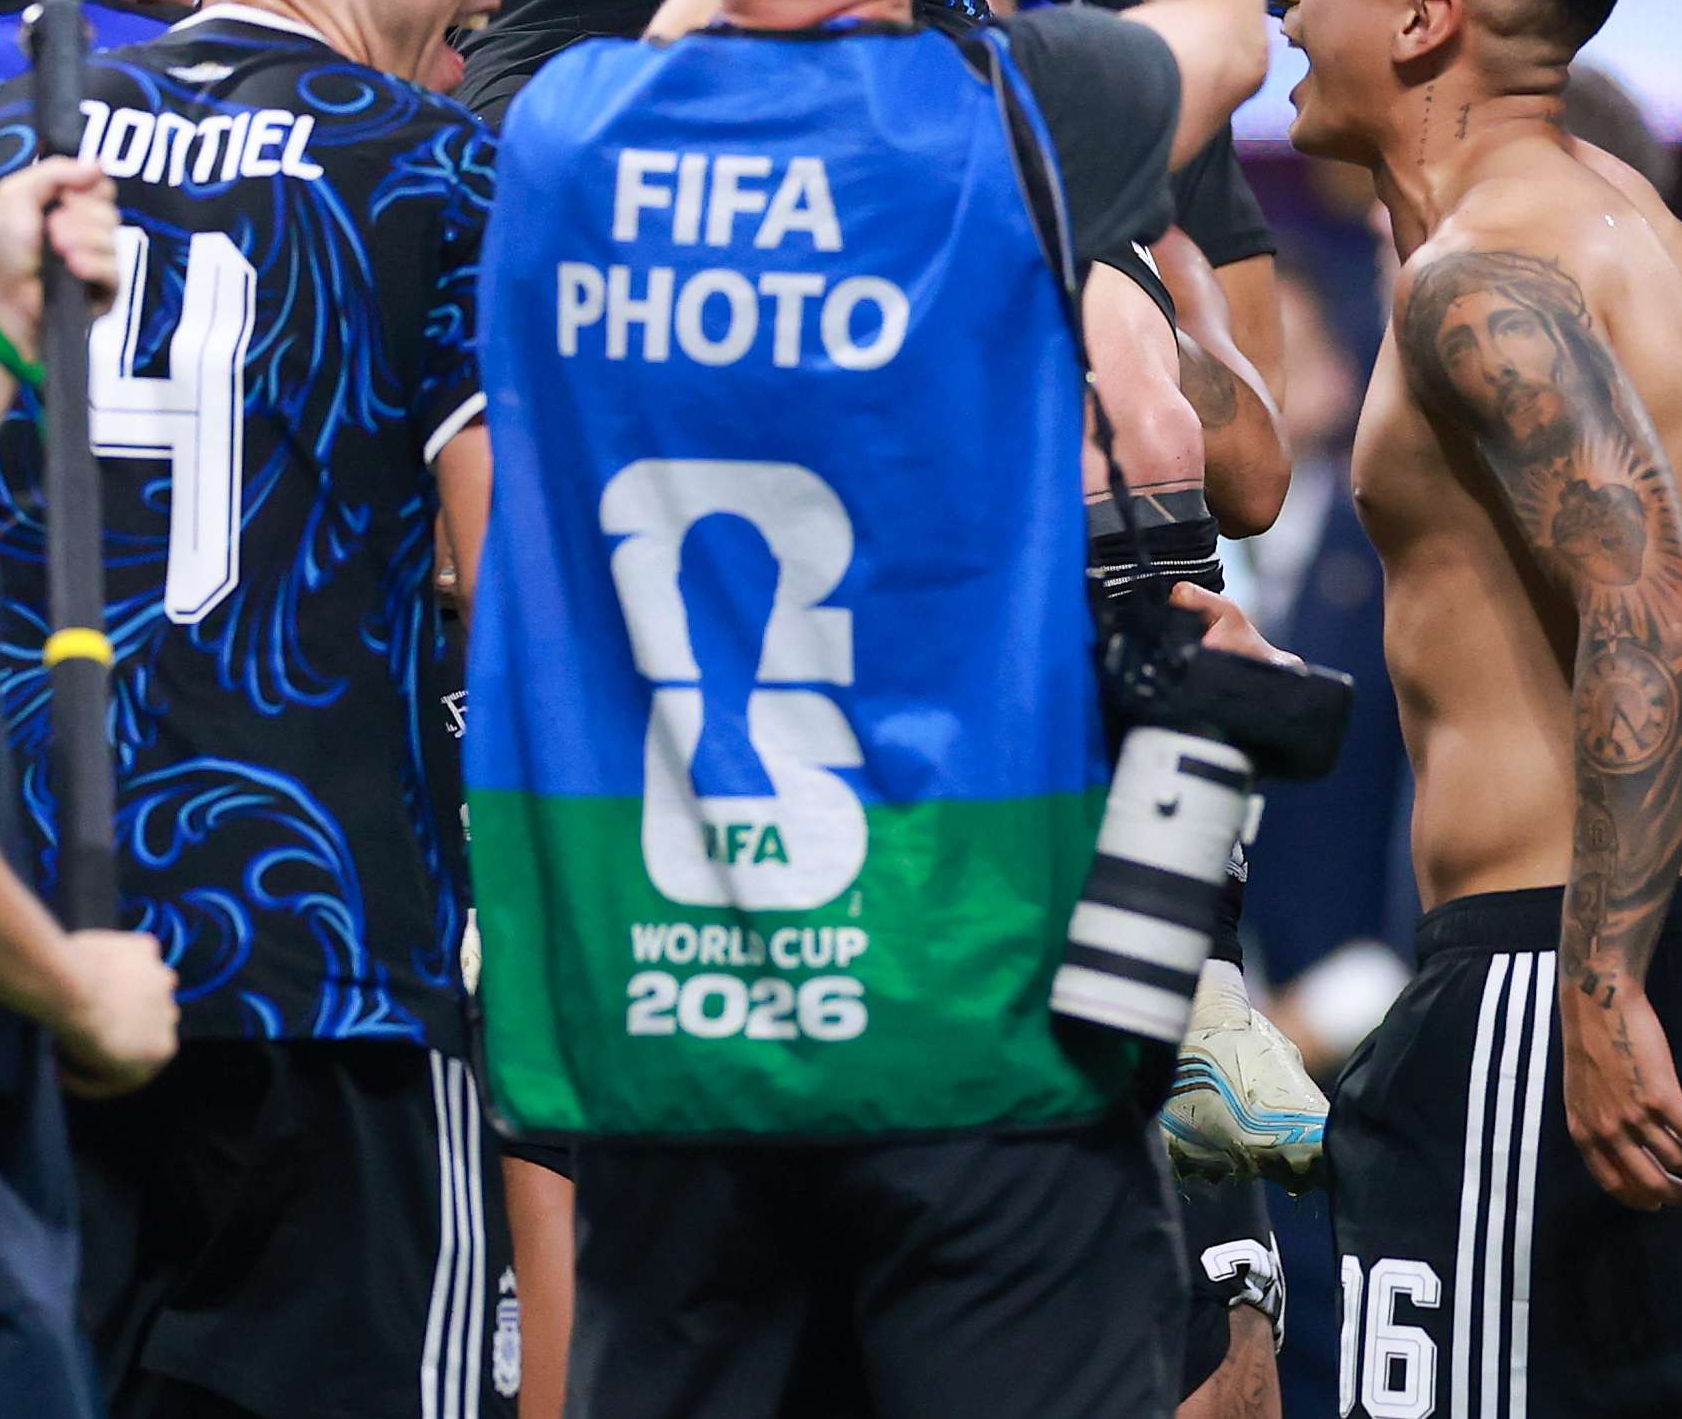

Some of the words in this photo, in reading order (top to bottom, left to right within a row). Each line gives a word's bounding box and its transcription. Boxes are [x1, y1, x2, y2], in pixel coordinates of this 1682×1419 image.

[612, 148, 844, 253] FIFA
[557, 261, 911, 371] PHOTO
[87, 226, 258, 625] 4
[770, 927, 868, 969] CUP
[627, 971, 868, 1042] 2026
